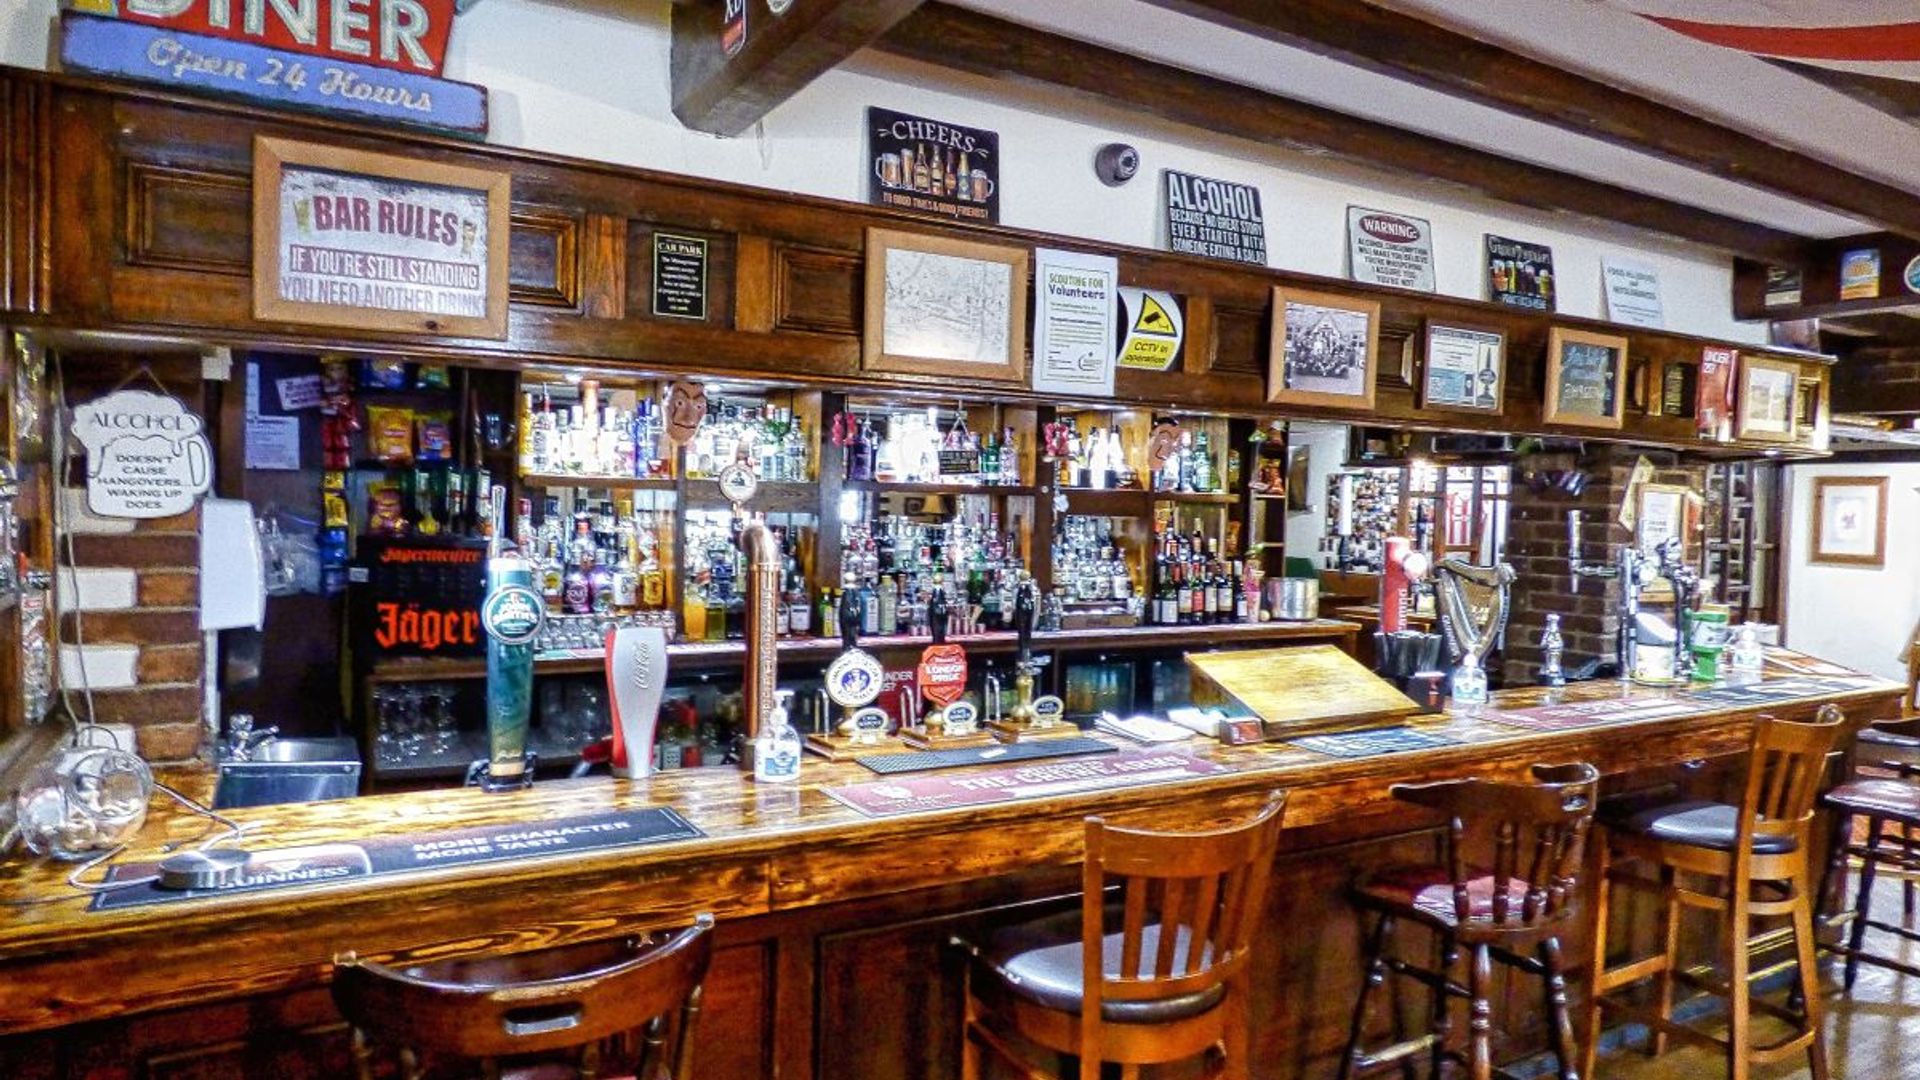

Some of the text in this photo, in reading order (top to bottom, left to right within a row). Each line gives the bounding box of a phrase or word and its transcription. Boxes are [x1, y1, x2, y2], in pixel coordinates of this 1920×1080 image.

[147, 38, 433, 113] Open 24 Hours
[892, 120, 976, 153] CHEERS
[1169, 173, 1263, 222] ALCOHOL
[312, 195, 458, 247] BAR RULES
[1170, 208, 1205, 225] BECAUSE
[1171, 222, 1264, 251] EVER STARTED WITH
[292, 246, 478, 288] IF YOU'RE STILL STANDING
[1048, 273, 1104, 288] SCOUTING FOR
[281, 276, 313, 302] YOU
[319, 280, 359, 306] NEED
[364, 283, 433, 311] ANOTHER
[1048, 284, 1106, 300] Volunteers
[1134, 342, 1159, 353] CCTV
[1125, 354, 1166, 364] operation
[90, 412, 184, 431] ALCOHOL
[116, 454, 173, 463] DOESN'T
[122, 466, 167, 475] CAUSE
[98, 477, 181, 487] HANGOVERS
[107, 489, 182, 498] WAKING UP
[126, 500, 162, 509] DOES
[411, 821, 631, 851] MORE CHARACTER
[415, 837, 570, 861] MORE TASTE
